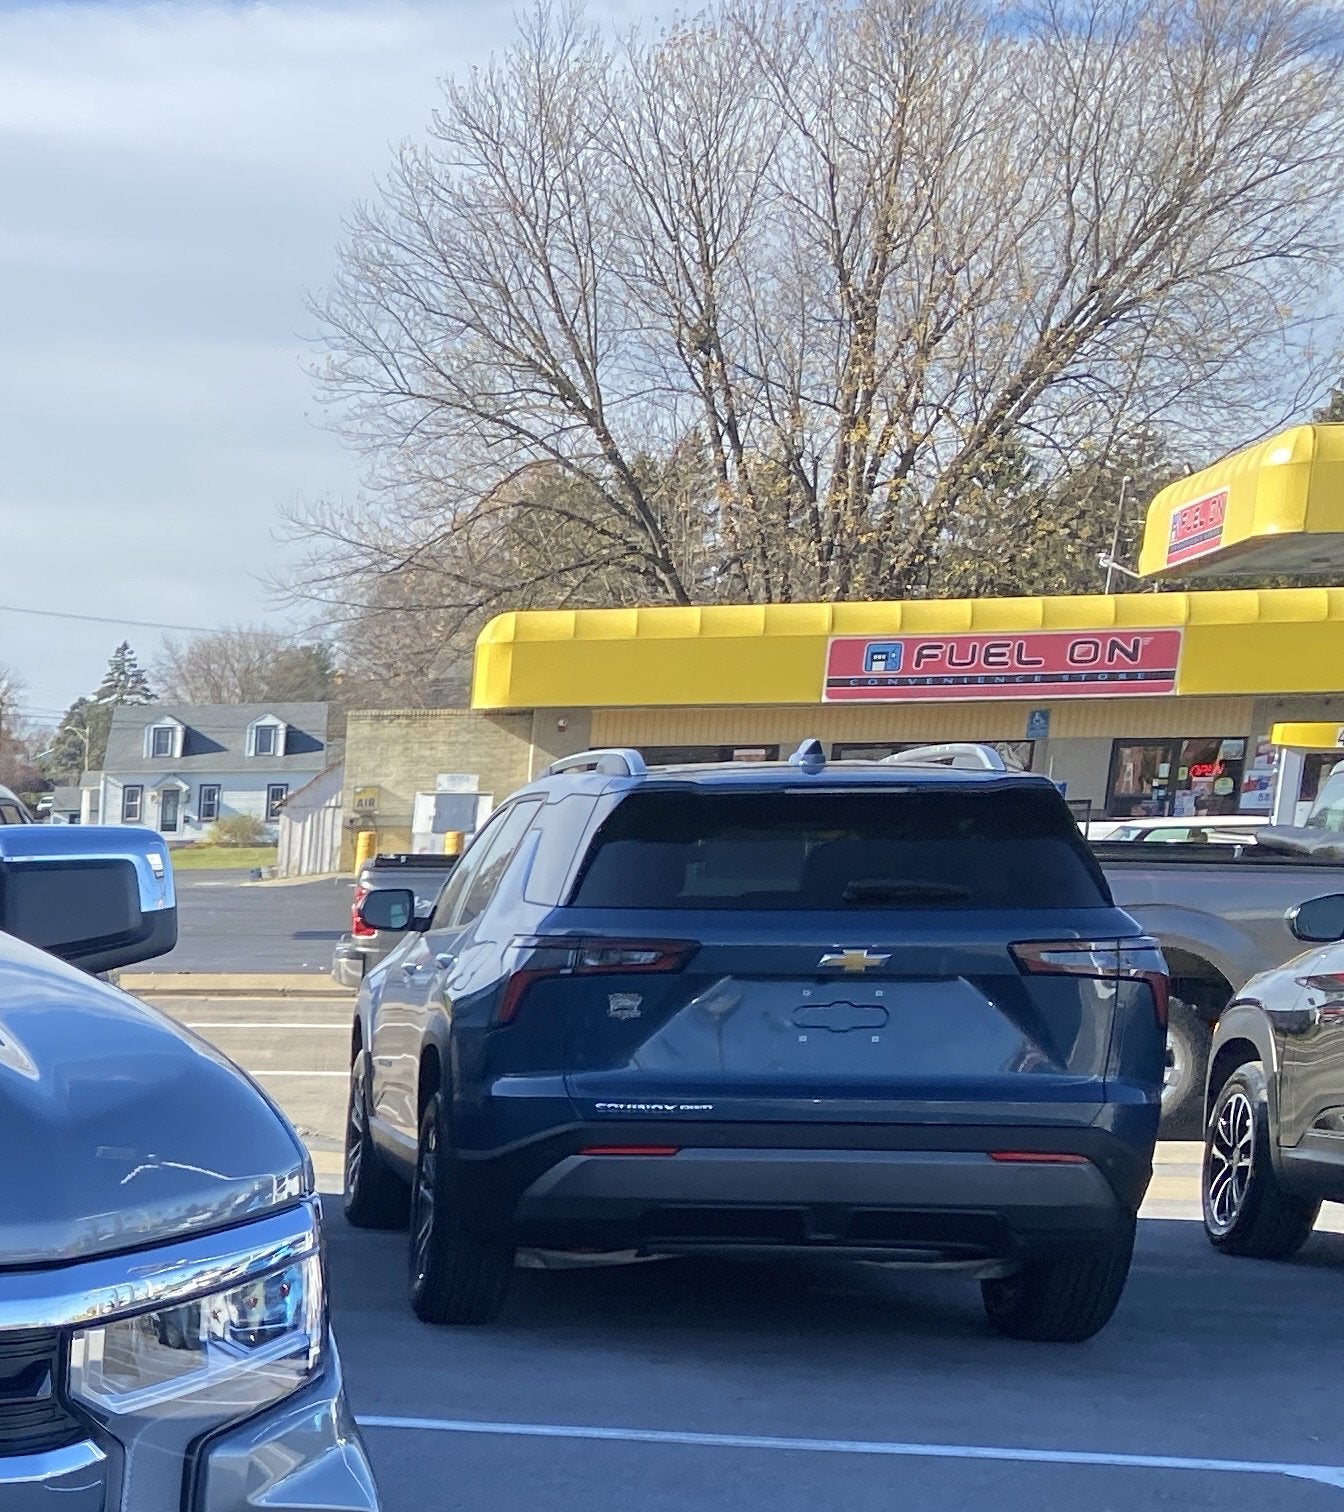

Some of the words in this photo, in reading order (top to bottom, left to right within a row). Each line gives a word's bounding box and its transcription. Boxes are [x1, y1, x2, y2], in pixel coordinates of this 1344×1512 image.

[913, 642, 1043, 669] FUEL
[1068, 637, 1141, 666] ON
[849, 674, 1042, 687] CONVENIENCE
[1062, 671, 1145, 682] STORE
[356, 798, 376, 808] AIR
